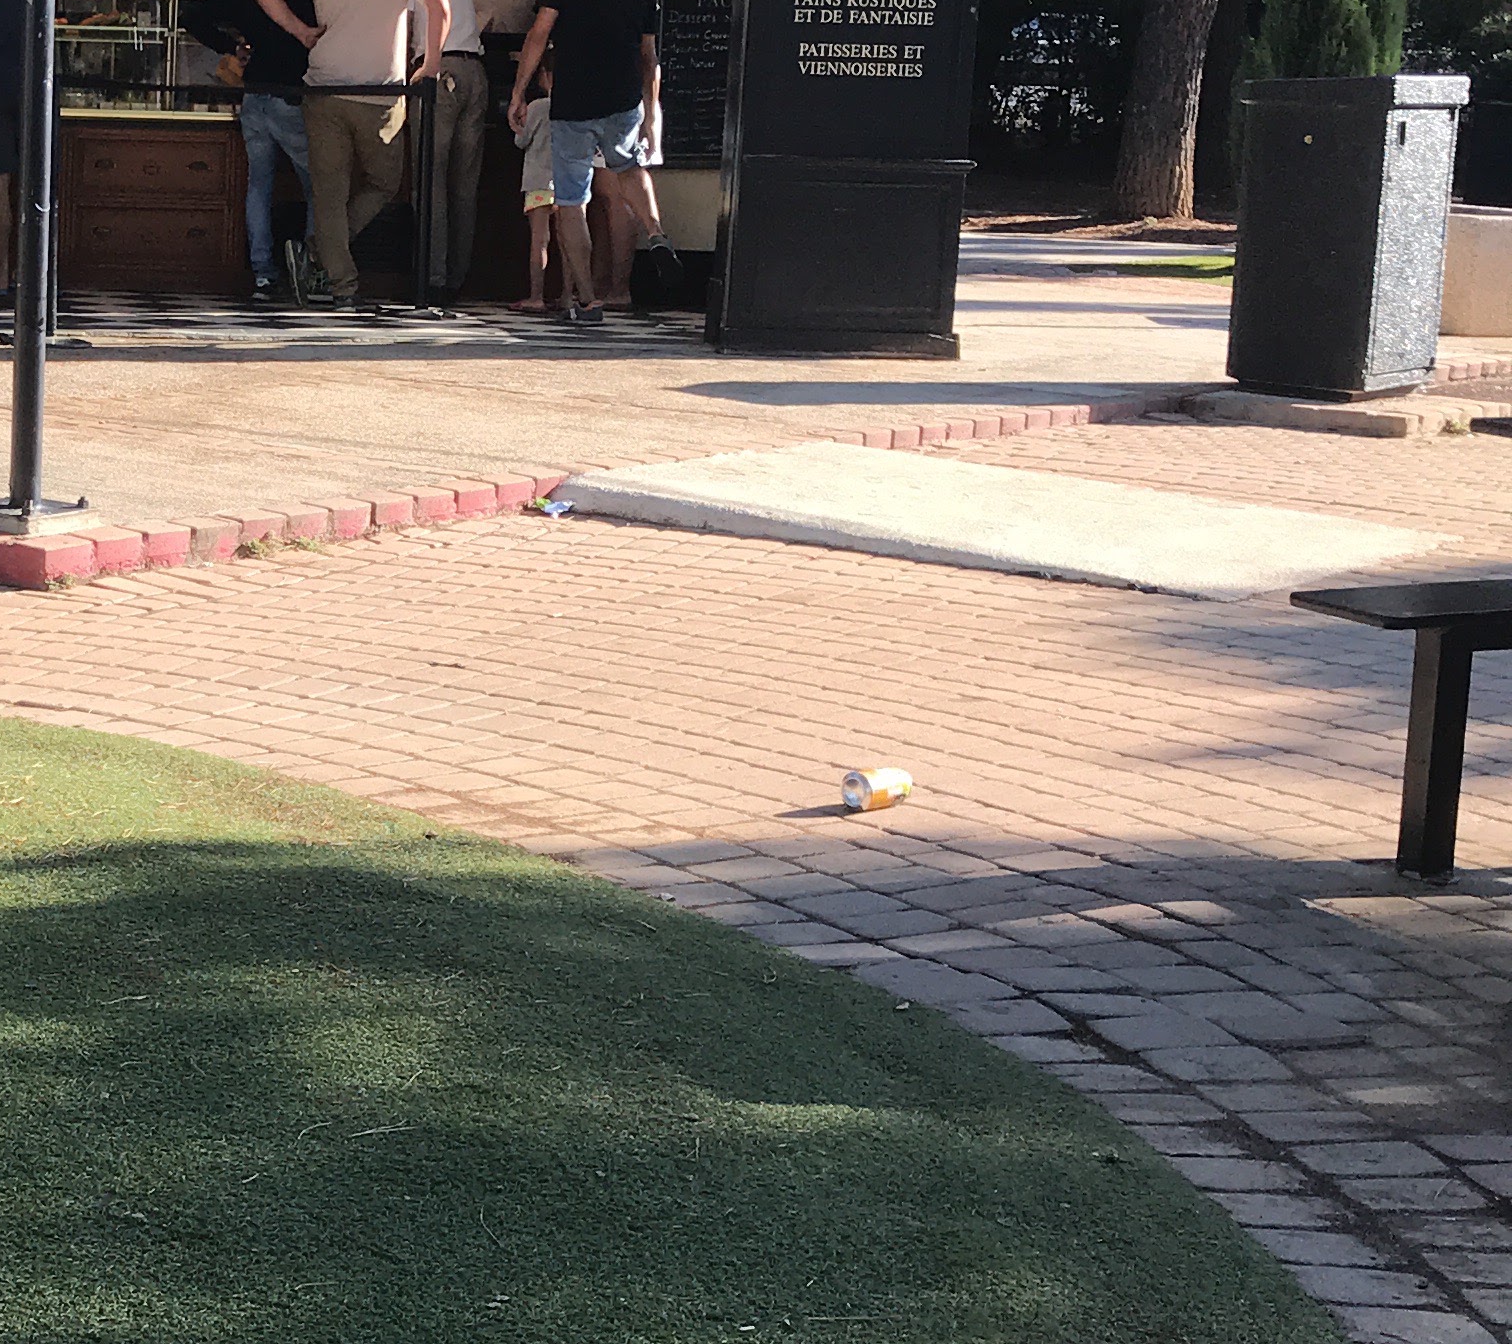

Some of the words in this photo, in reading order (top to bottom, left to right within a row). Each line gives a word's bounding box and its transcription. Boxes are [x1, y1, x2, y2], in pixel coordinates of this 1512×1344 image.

[794, 9, 815, 22] ET
[821, 10, 842, 23] DE
[849, 11, 934, 25] FANTAISIE
[800, 43, 897, 58] PATISSERIES
[904, 46, 924, 58] ET
[798, 61, 922, 77] VIENNOISERIES
